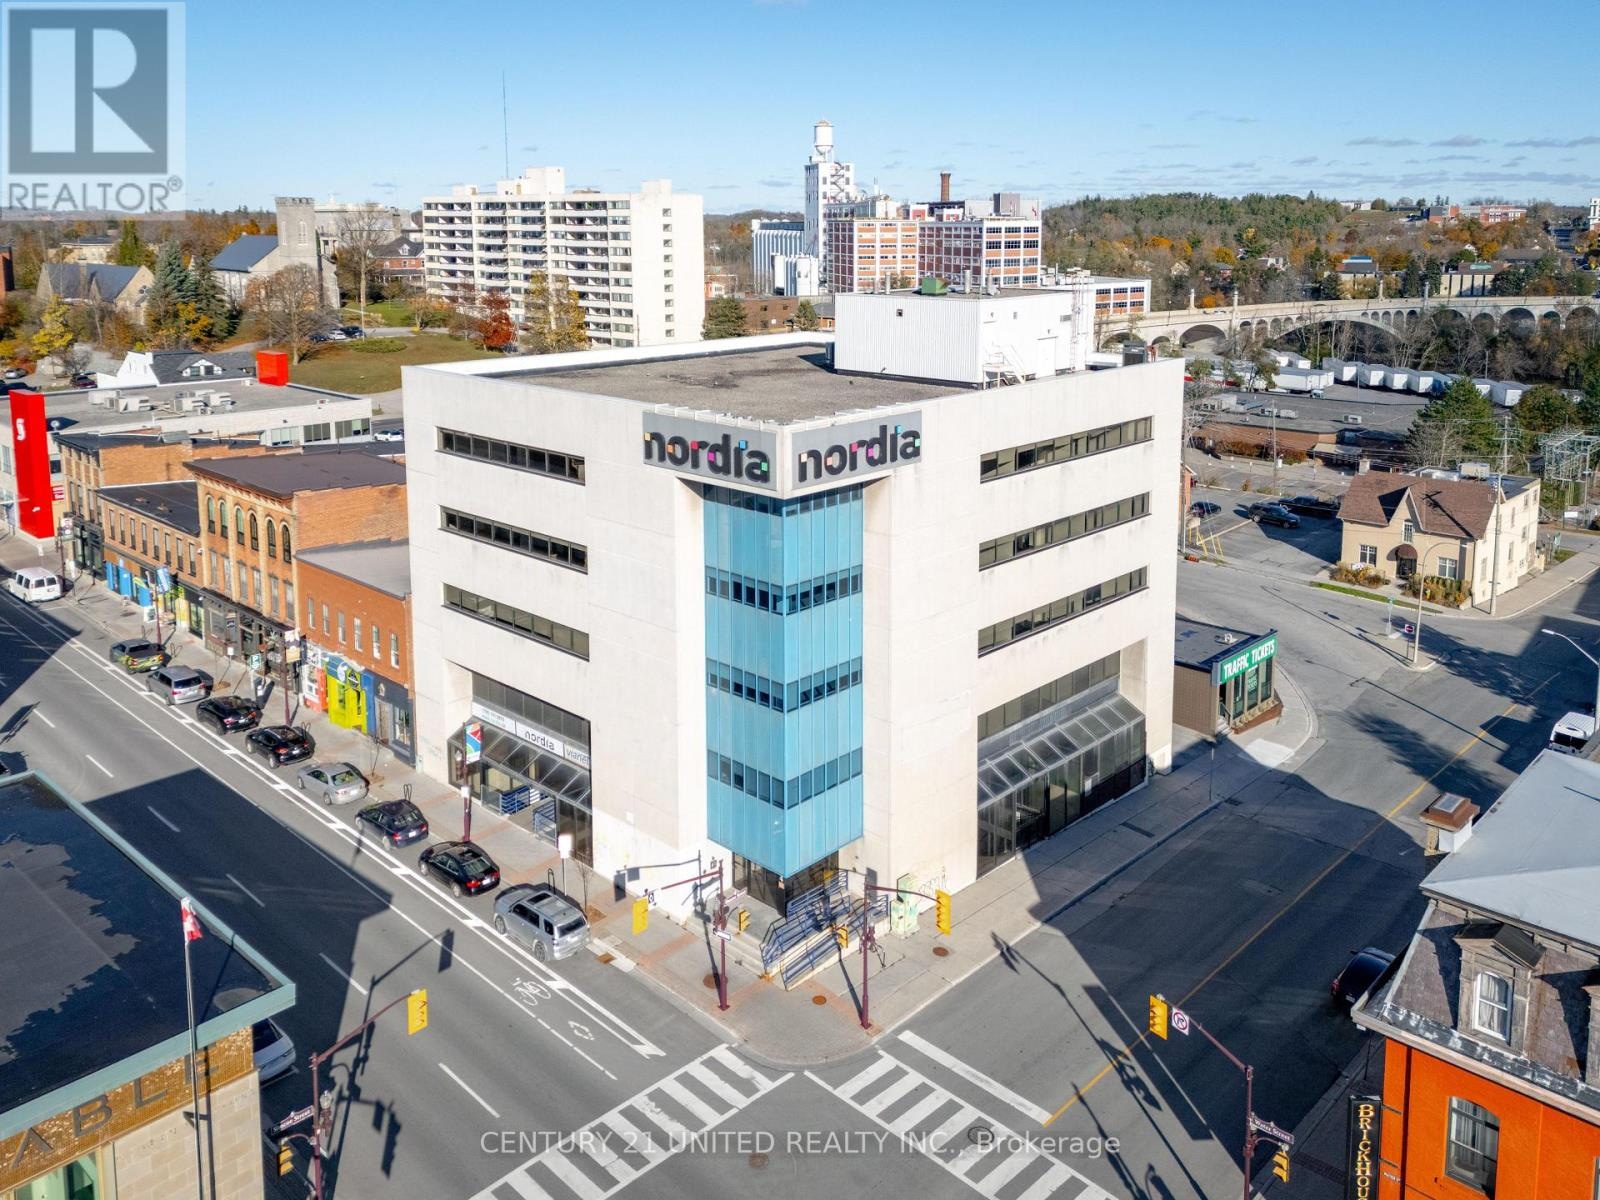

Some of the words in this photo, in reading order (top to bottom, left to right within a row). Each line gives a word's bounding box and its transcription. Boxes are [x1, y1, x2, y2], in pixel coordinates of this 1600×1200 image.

[643, 431, 770, 483] nordia
[798, 424, 921, 483] nordia
[1223, 652, 1250, 680] TRAFFIC
[1251, 639, 1275, 664] TICKETS
[524, 730, 555, 751] nordia
[1254, 1119, 1271, 1132] Water
[1272, 1127, 1291, 1140] Street
[1354, 1103, 1376, 1200] BRICKHOU
